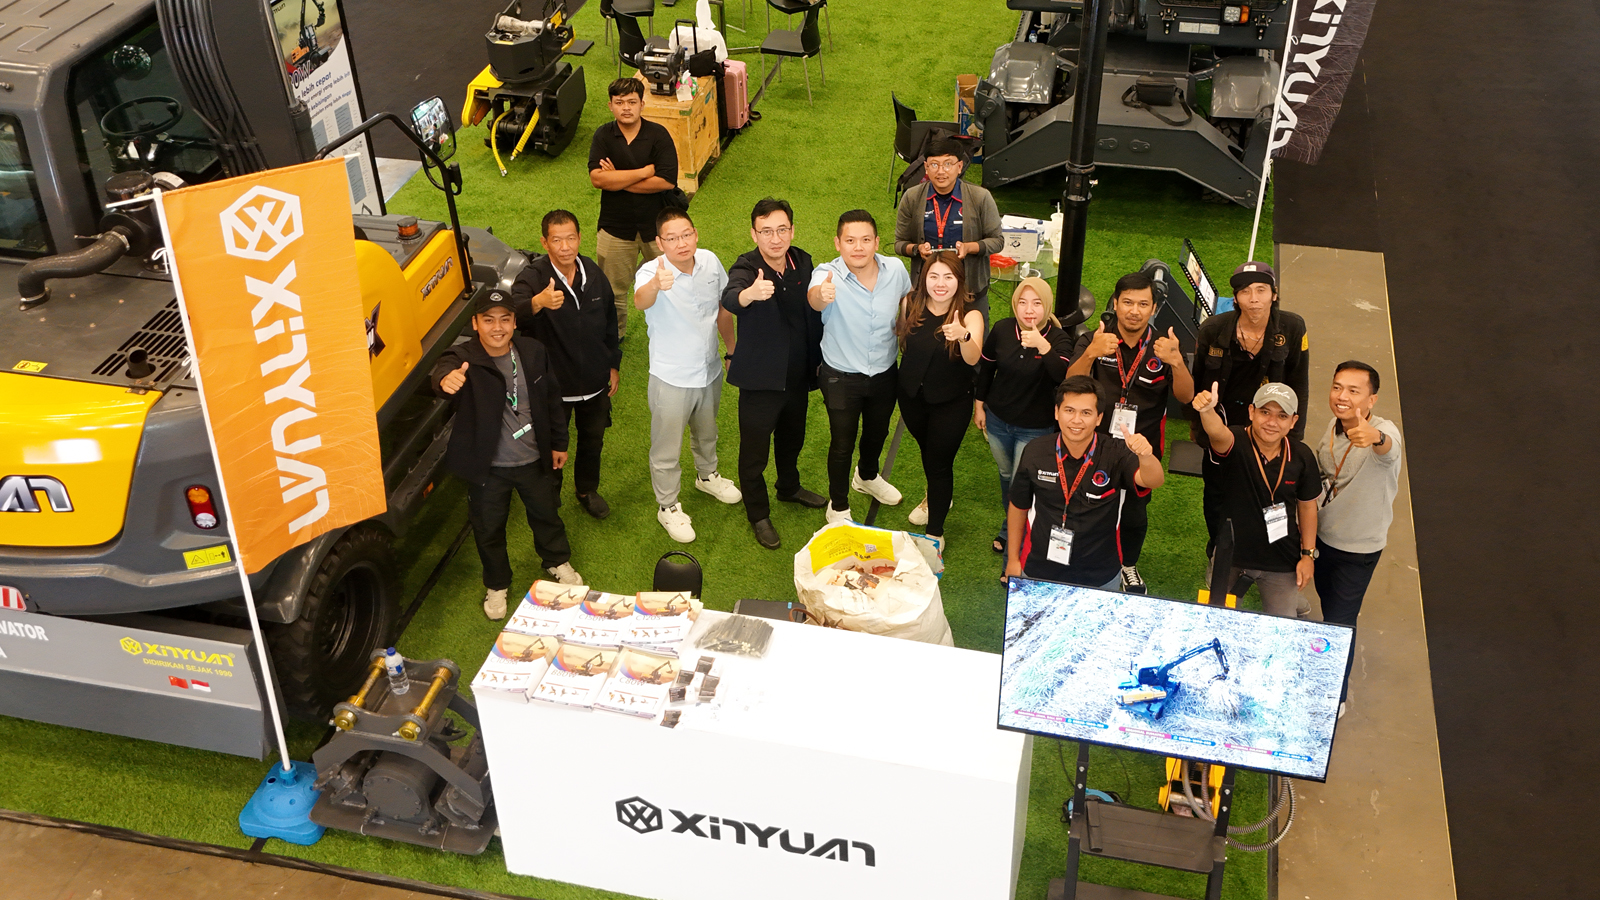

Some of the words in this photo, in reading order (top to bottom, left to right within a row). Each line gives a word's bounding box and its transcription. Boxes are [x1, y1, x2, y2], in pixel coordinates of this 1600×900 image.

[301, 82, 315, 98] lebih
[315, 71, 332, 87] cepat
[0, 620, 49, 641] VATOR
[142, 657, 185, 671] DIDIRIKAN
[185, 663, 213, 676] SEJAK
[214, 668, 233, 678] 1990
